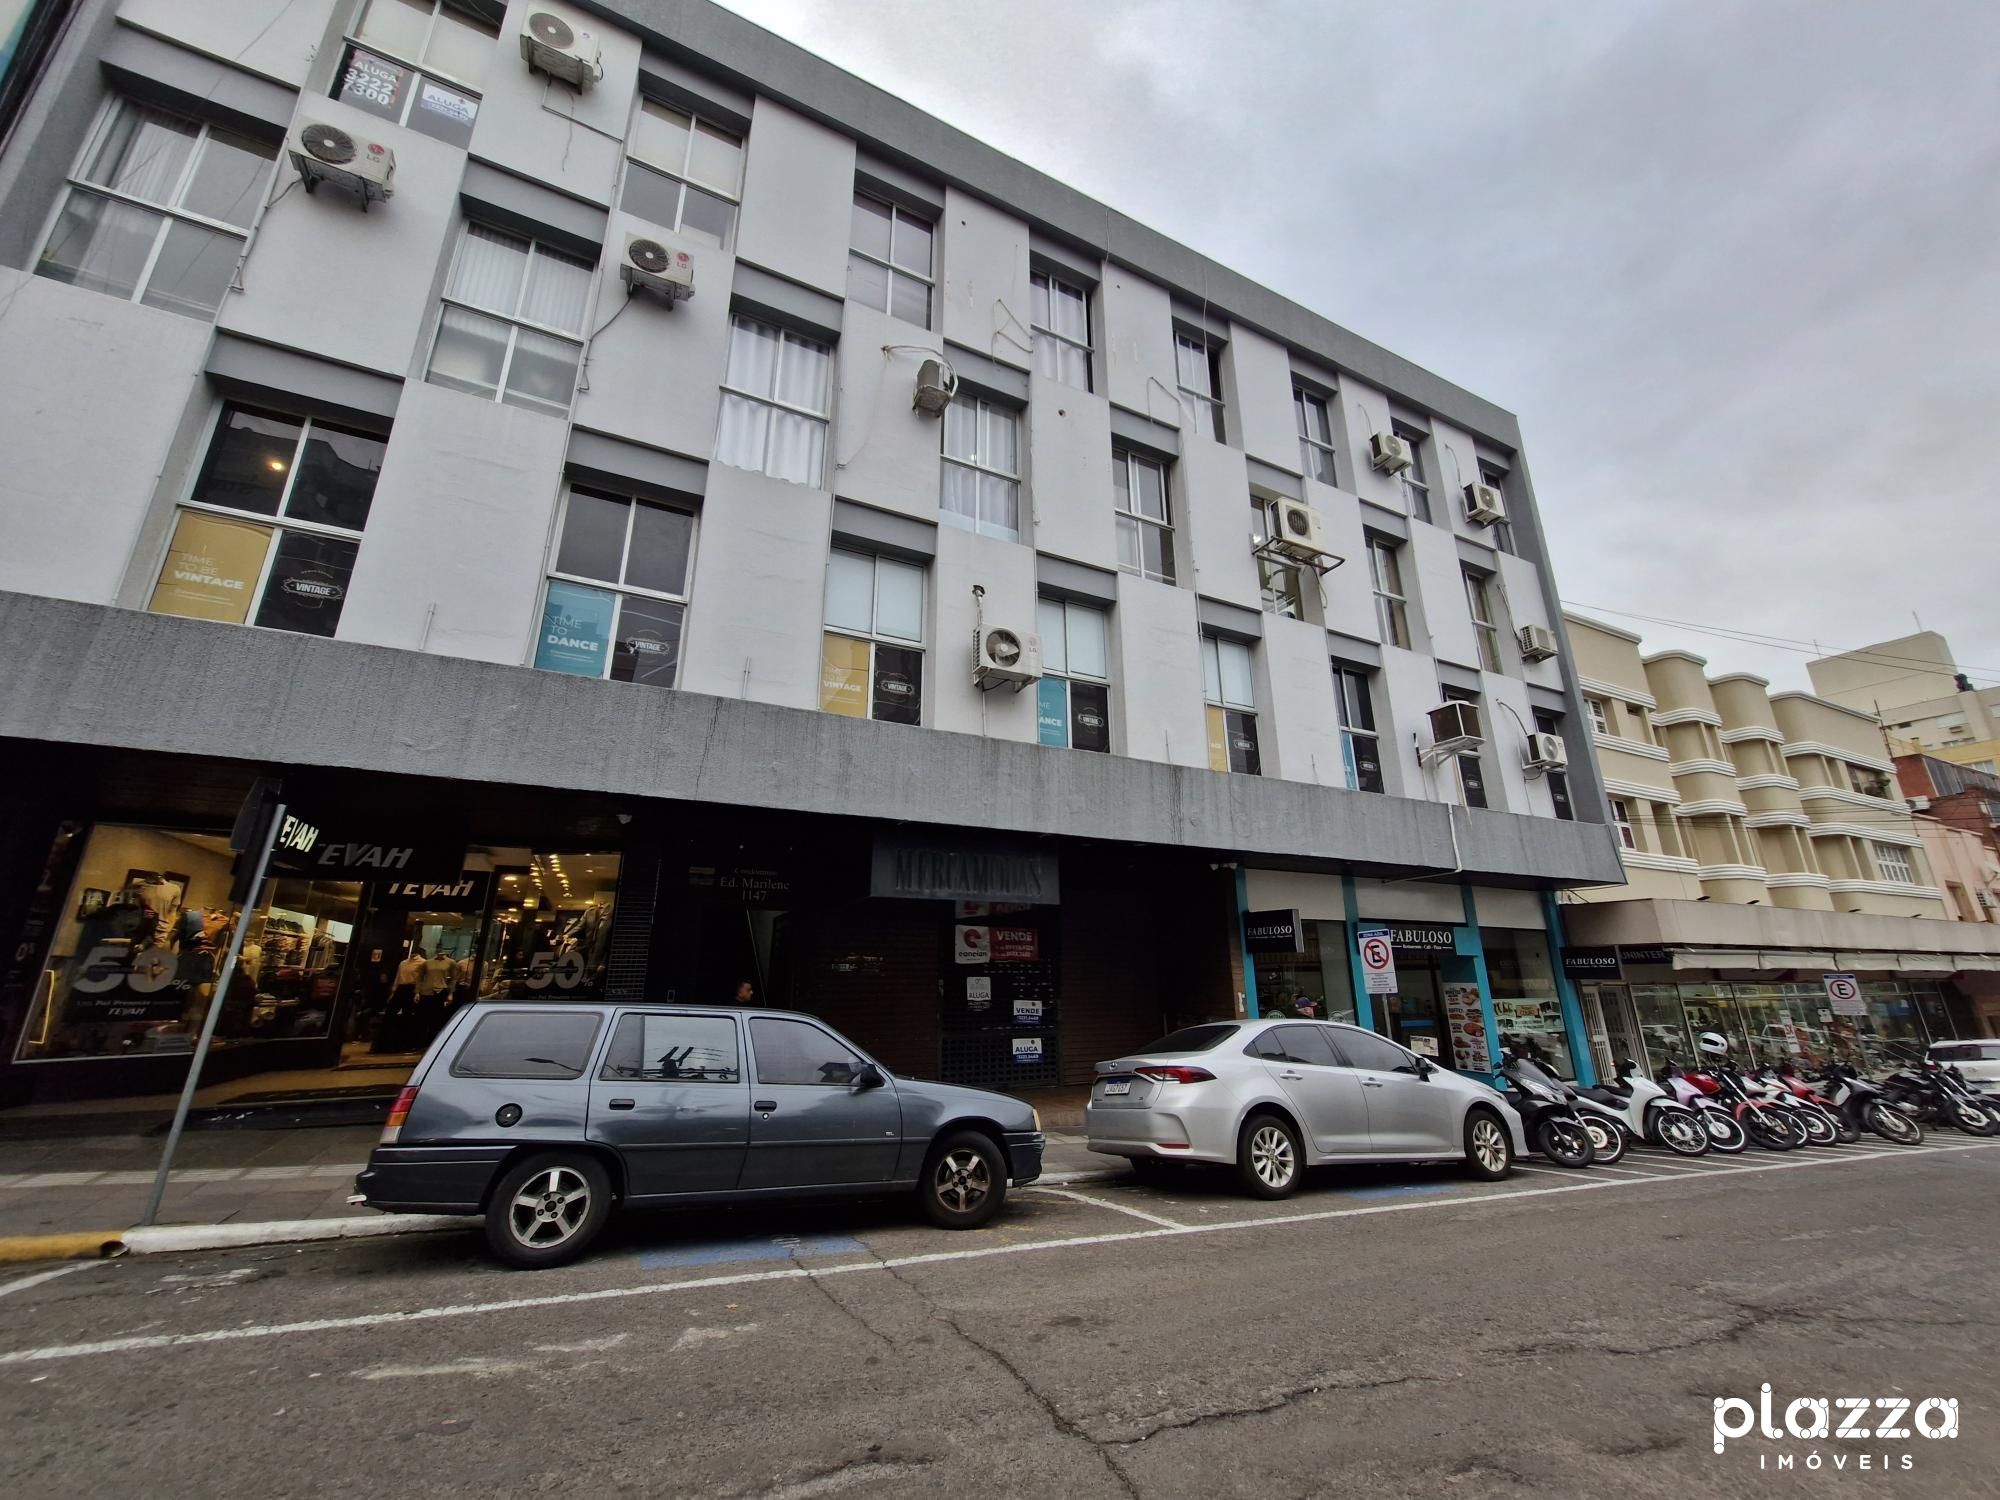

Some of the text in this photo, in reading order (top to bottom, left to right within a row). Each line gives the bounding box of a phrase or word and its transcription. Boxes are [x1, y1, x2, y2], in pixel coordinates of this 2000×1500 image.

[354, 61, 397, 83] ALUGA
[346, 68, 394, 96] 3222
[427, 94, 470, 115] ALUGA
[366, 153, 381, 163] LG
[182, 552, 214, 566] TIME
[178, 561, 219, 576] TO BE
[174, 570, 246, 590] VINTAGE
[295, 582, 332, 596] VINTAGE
[552, 615, 583, 629] TIME
[551, 626, 568, 636] TO
[547, 634, 599, 652] DANCE
[635, 640, 662, 652] VINTAGE
[823, 680, 864, 692] VINTAGE
[318, 843, 414, 869] EVAH
[720, 877, 791, 890] Ed. Marilene
[742, 890, 768, 901] 1147
[997, 930, 1033, 941] VENDE
[1247, 925, 1292, 937] FABULOSO
[1391, 929, 1452, 944] FABULOSO
[73, 947, 179, 993] 50
[525, 952, 584, 989] 50
[1837, 984, 1848, 996] E
